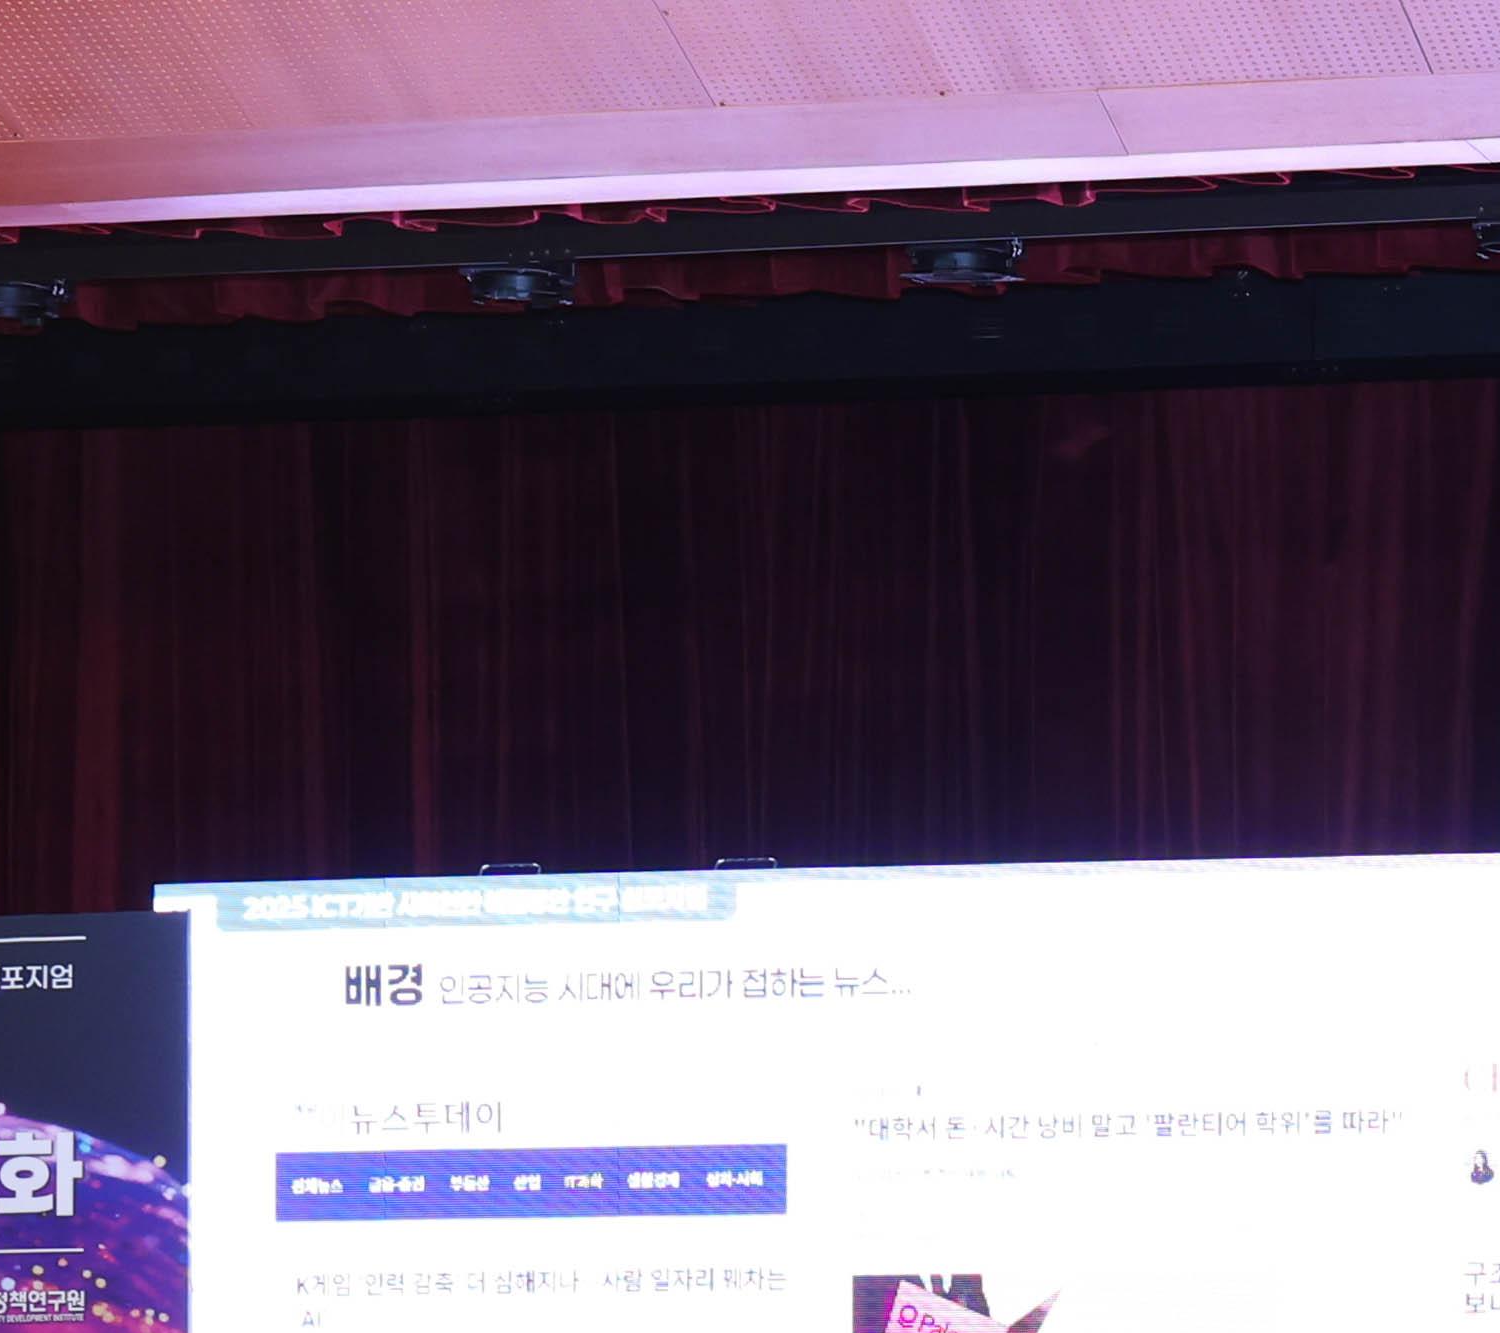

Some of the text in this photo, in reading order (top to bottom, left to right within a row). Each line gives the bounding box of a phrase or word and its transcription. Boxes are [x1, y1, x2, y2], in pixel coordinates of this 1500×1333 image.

[344, 963, 424, 1007] 배경
[439, 971, 549, 1006] 인공지능
[558, 970, 640, 1003] 시대에
[650, 968, 732, 1000] 우리가
[741, 967, 825, 999] 접하는
[350, 1100, 502, 1134] 뉴스투데이
[1038, 1113, 1083, 1140] 낭비
[1092, 1112, 1137, 1139] 말고
[296, 1272, 351, 1297] K게임
[467, 1271, 485, 1293] 더
[603, 1269, 644, 1292] 사람
[651, 1269, 715, 1291] 일자리
[300, 1309, 322, 1328] AI
